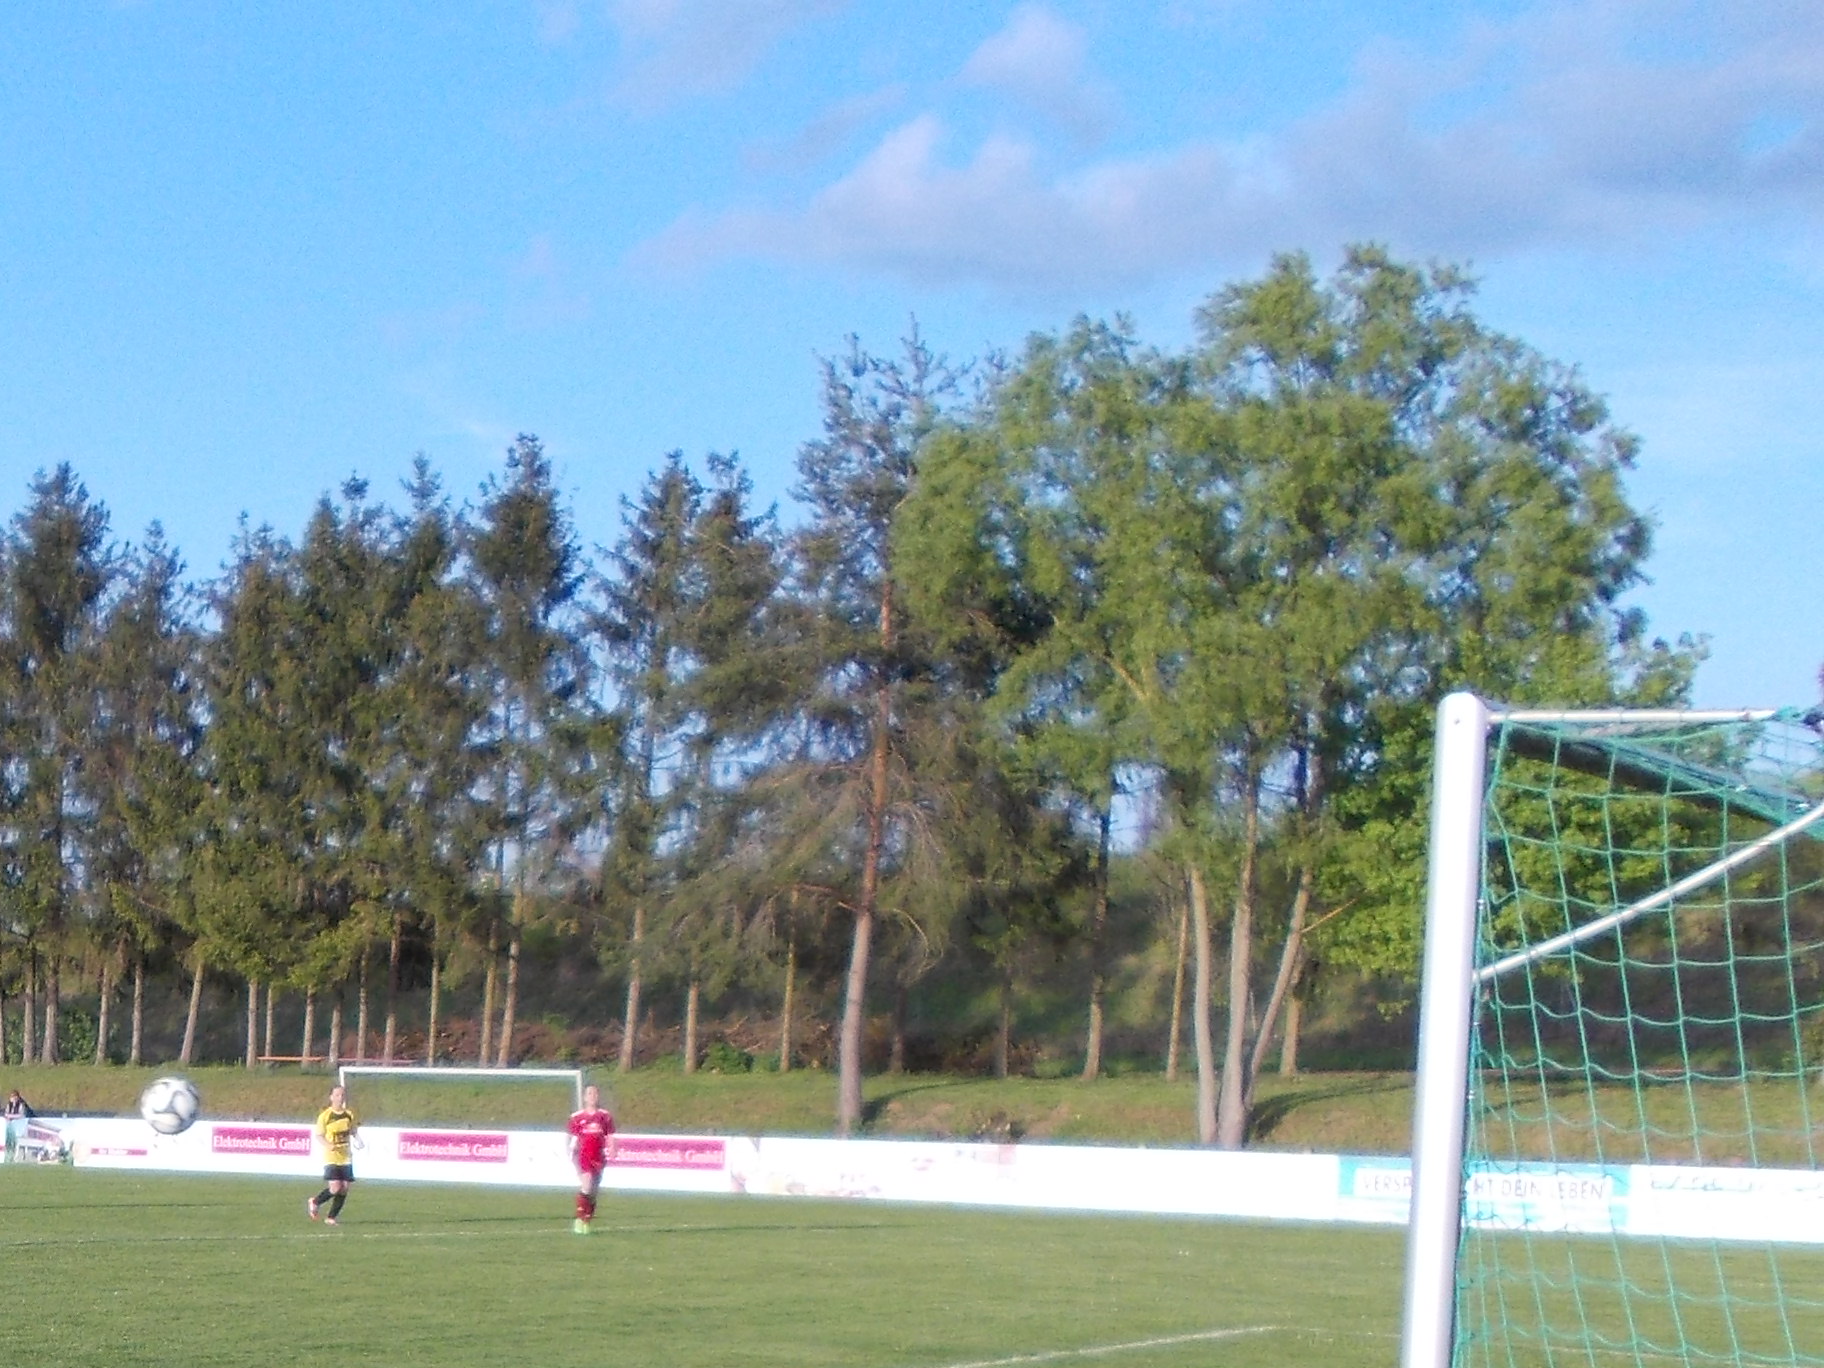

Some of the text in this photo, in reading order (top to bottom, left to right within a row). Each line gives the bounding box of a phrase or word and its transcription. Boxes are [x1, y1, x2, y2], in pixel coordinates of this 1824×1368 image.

[213, 1135, 311, 1151] Elektrotechnik GmbH
[399, 1141, 508, 1158] Elektrotechnik GmbH
